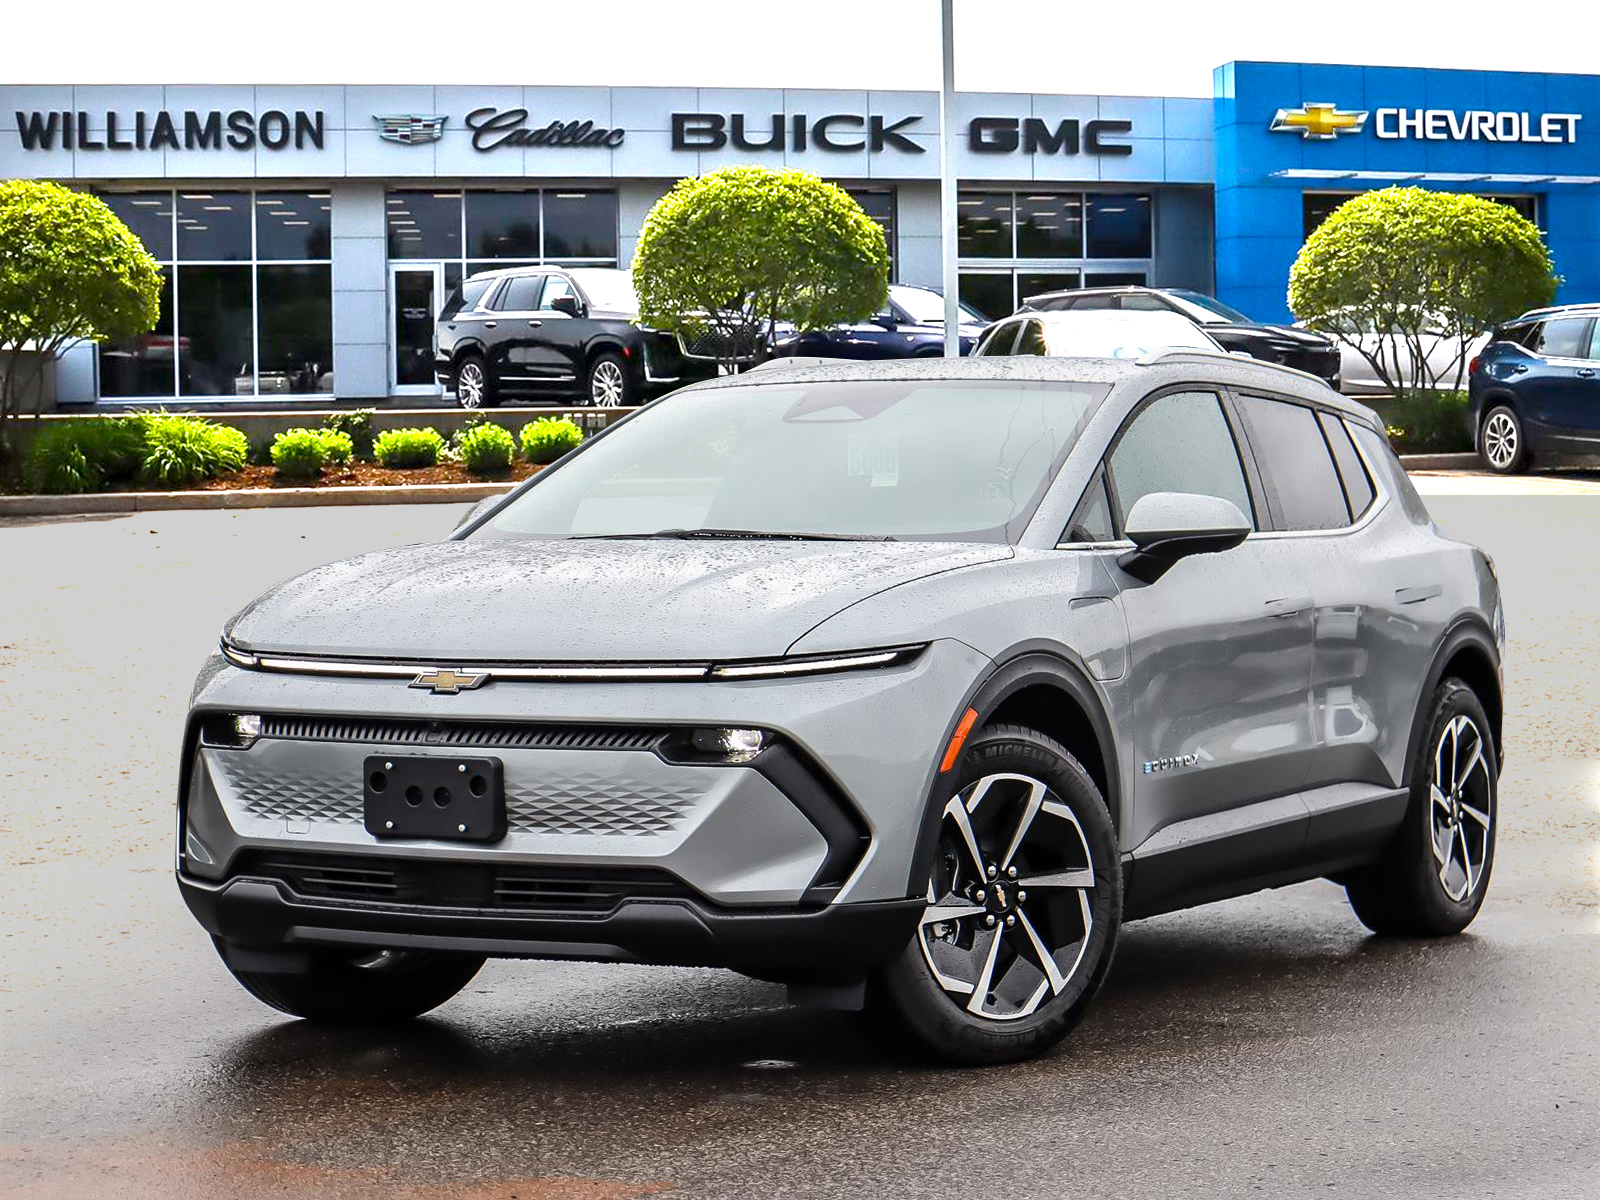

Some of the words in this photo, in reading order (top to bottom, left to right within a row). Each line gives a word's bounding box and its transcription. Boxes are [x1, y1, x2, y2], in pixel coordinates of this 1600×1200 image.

[15, 111, 324, 151] WILLIAMSON
[465, 107, 625, 152] Cadillac
[671, 113, 927, 153] BUICK
[969, 117, 1133, 155] GMC
[1376, 108, 1582, 143] CHEVROLET
[985, 744, 1056, 767] MICHELIN
